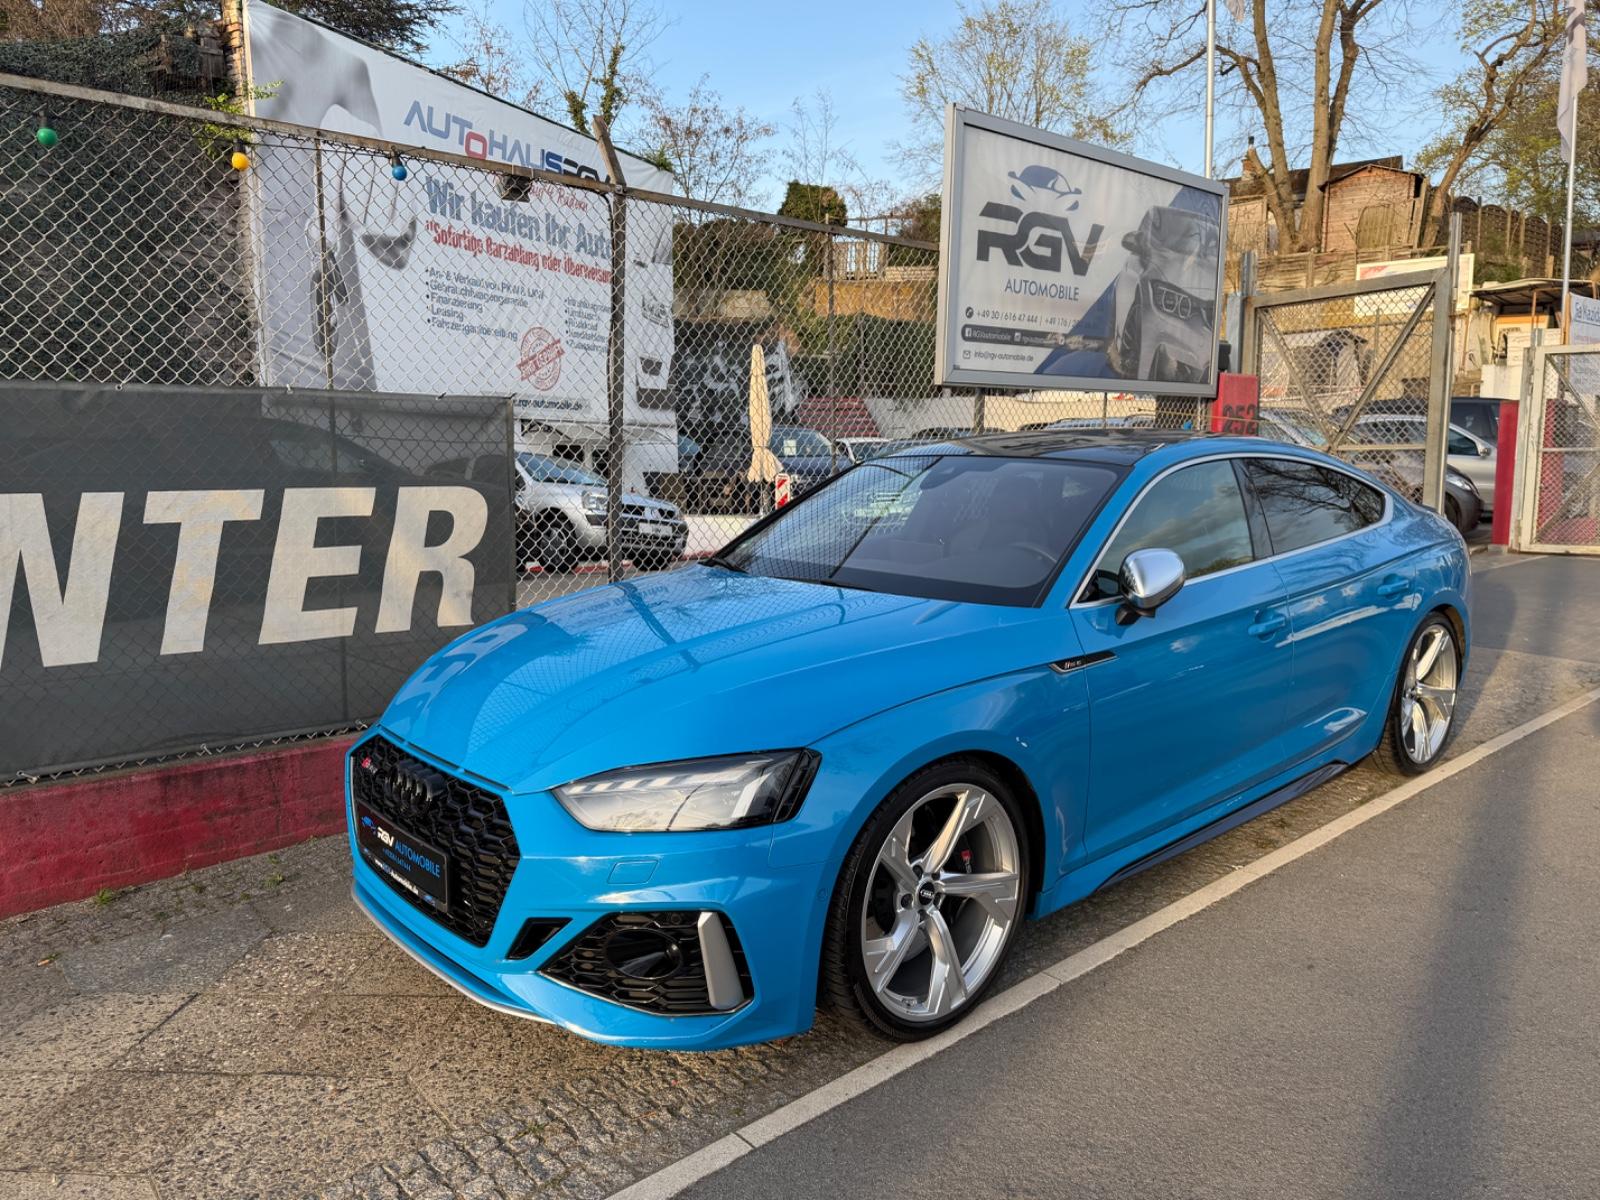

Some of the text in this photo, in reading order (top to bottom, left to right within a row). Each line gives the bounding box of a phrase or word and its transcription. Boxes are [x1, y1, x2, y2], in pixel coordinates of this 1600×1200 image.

[426, 176, 464, 221] Wir
[471, 191, 541, 242] kaufen
[545, 213, 570, 250] Ihr
[486, 236, 540, 272] Barzahlung
[542, 254, 562, 273] oder
[976, 201, 1104, 277] RGV
[1004, 278, 1079, 302] AUTOMOBILE
[395, 840, 441, 878] AUTOMOBILE
